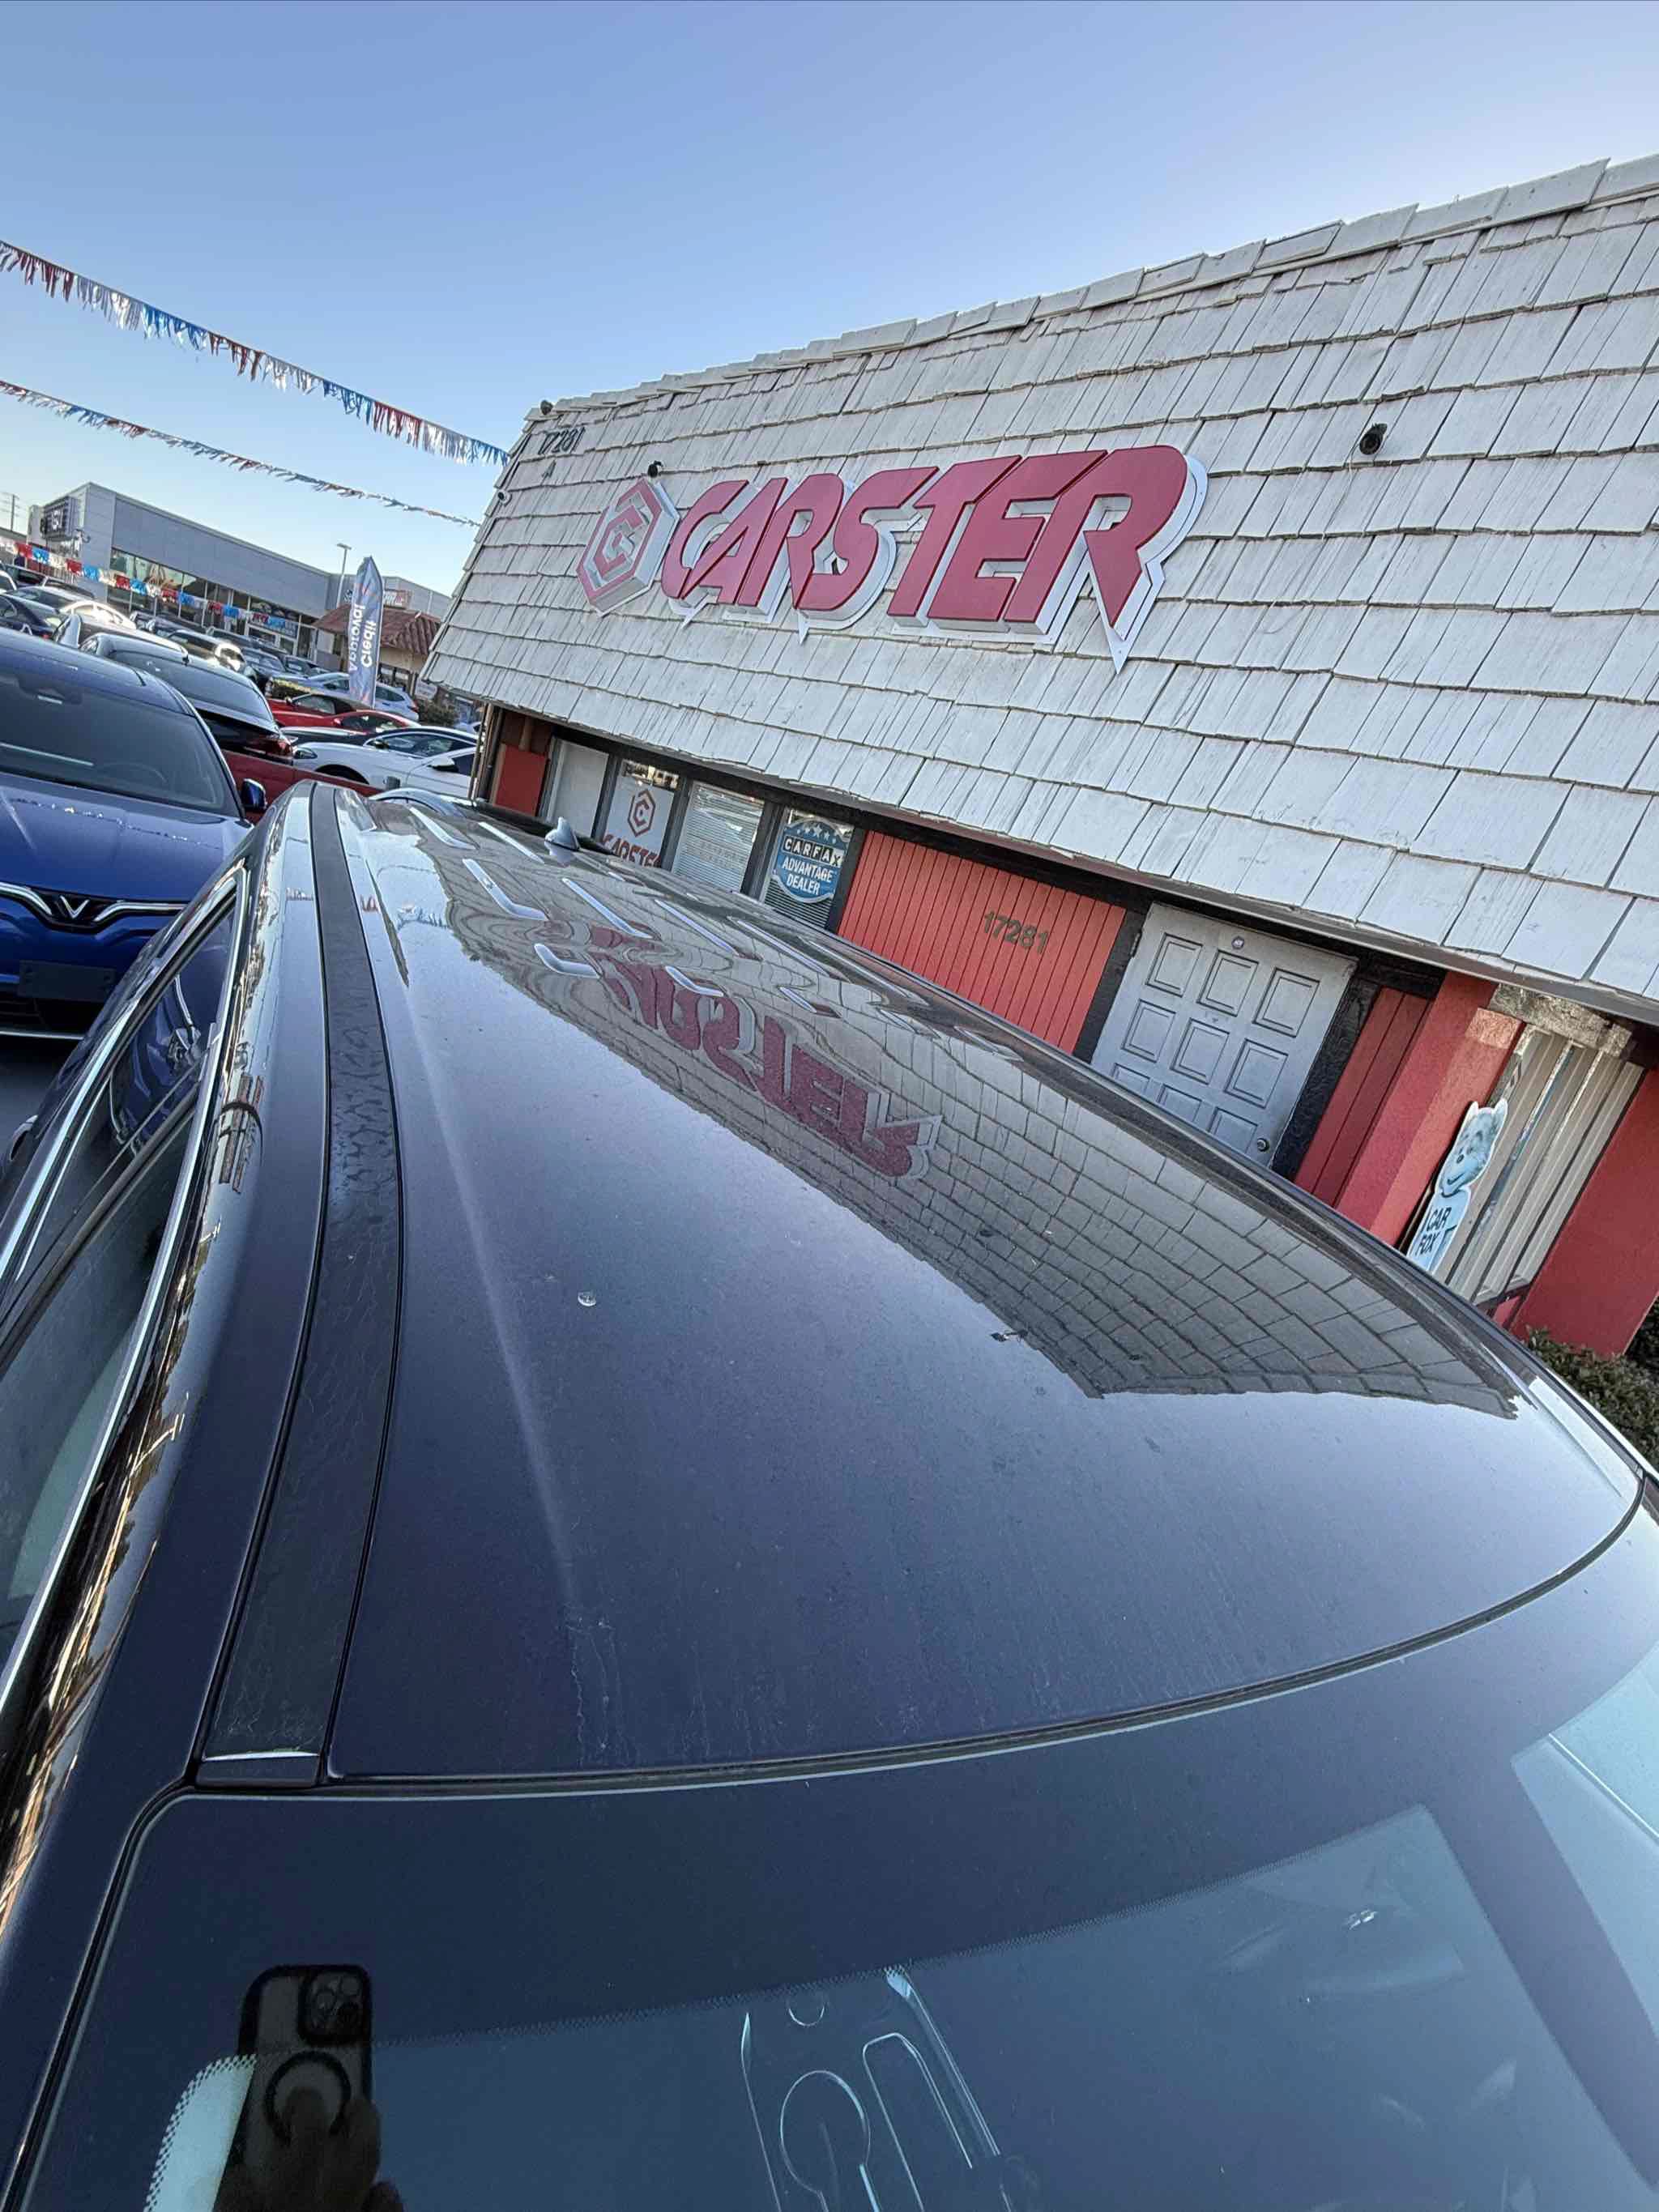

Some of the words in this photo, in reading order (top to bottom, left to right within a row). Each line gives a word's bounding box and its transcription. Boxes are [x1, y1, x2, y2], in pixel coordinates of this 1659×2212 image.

[661, 445, 1197, 637] CARSTER
[784, 837, 842, 867] CARFAX
[782, 856, 834, 883] ADVANTAGE
[787, 873, 821, 896] DEALER
[984, 911, 1049, 954] 17281
[1427, 1207, 1452, 1232] CAR
[1414, 1231, 1441, 1255] FOX
